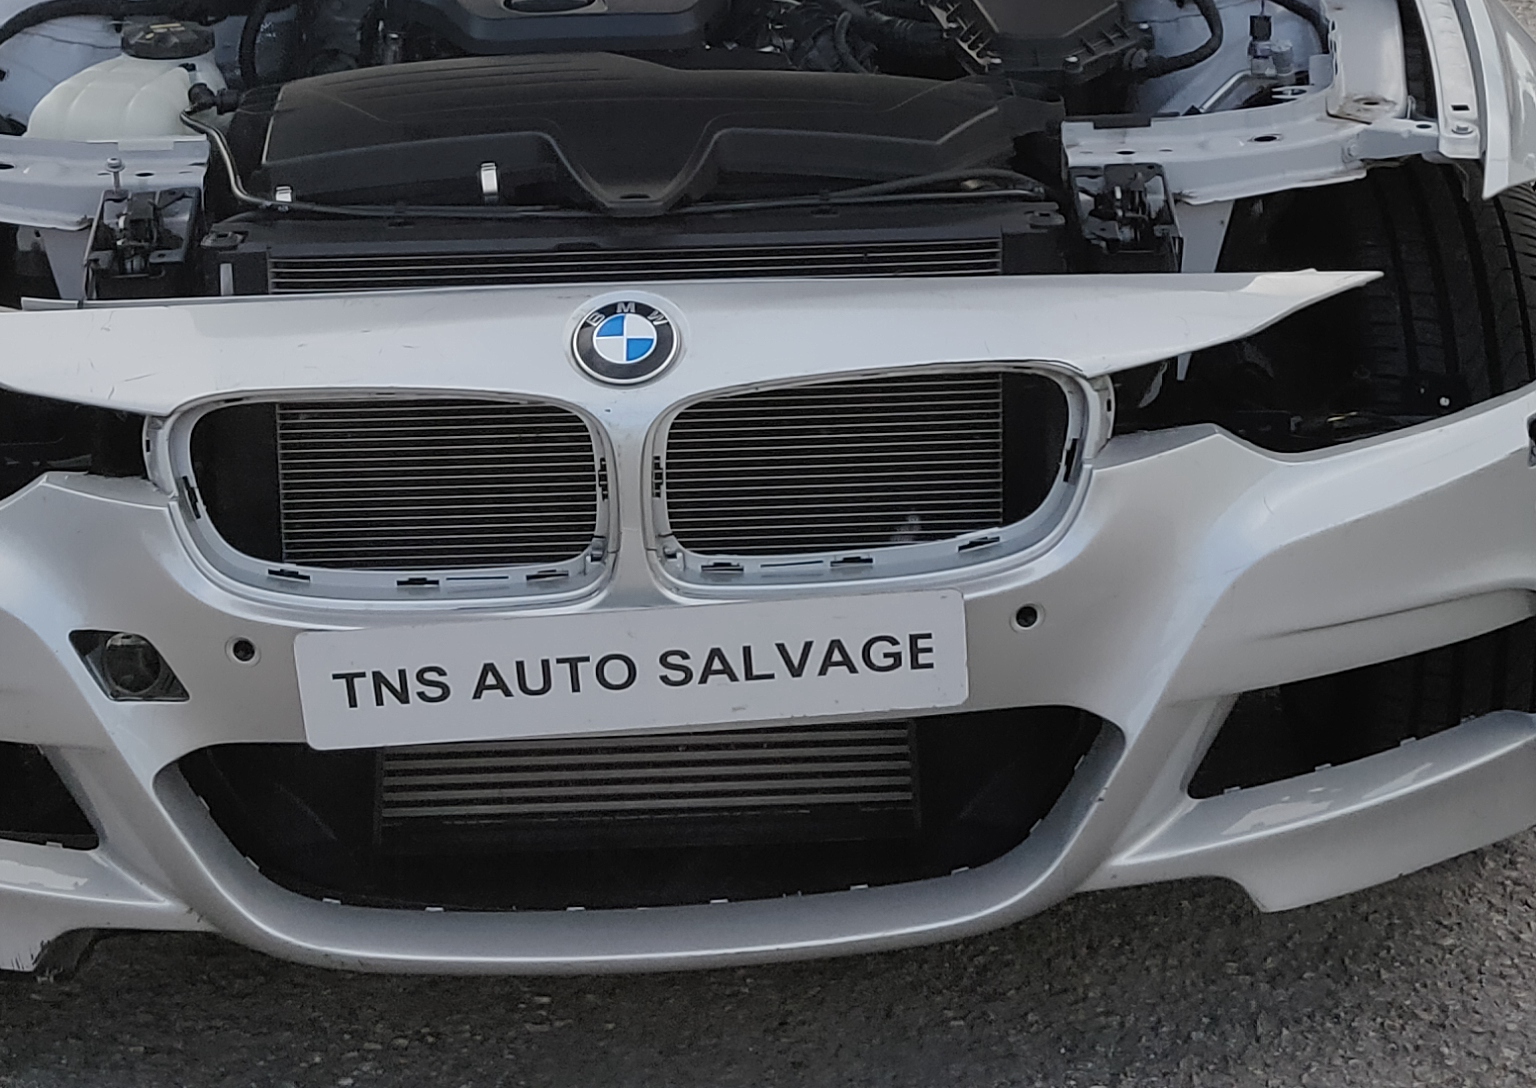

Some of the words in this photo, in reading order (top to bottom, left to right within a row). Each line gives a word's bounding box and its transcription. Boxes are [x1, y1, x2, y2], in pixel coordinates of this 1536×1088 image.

[586, 302, 670, 327] BMW
[332, 664, 452, 709] TNS
[471, 652, 638, 700] AUTO
[658, 632, 936, 688] SALVAGE
